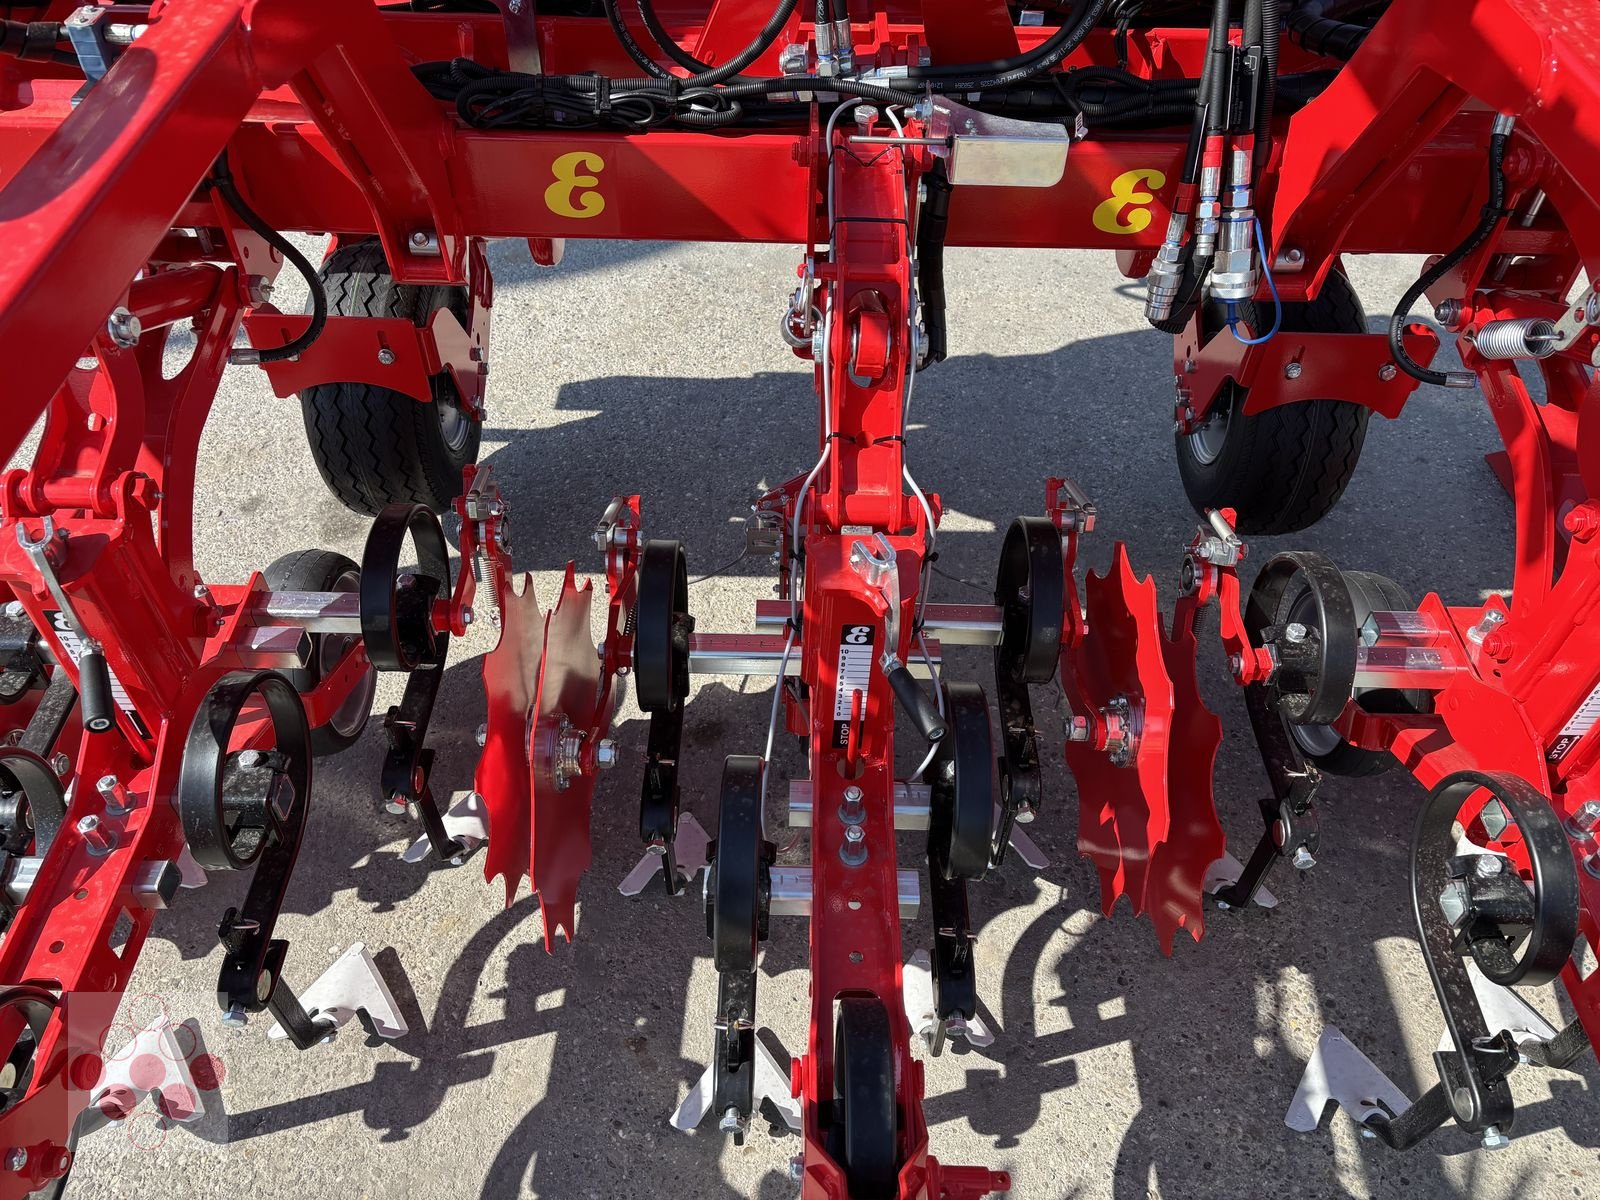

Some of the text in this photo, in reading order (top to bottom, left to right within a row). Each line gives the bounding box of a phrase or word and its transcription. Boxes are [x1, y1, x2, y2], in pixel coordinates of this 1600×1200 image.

[1007, 70, 1026, 82] Poland
[840, 723, 849, 745] STOP
[1549, 738, 1569, 759] STOP
